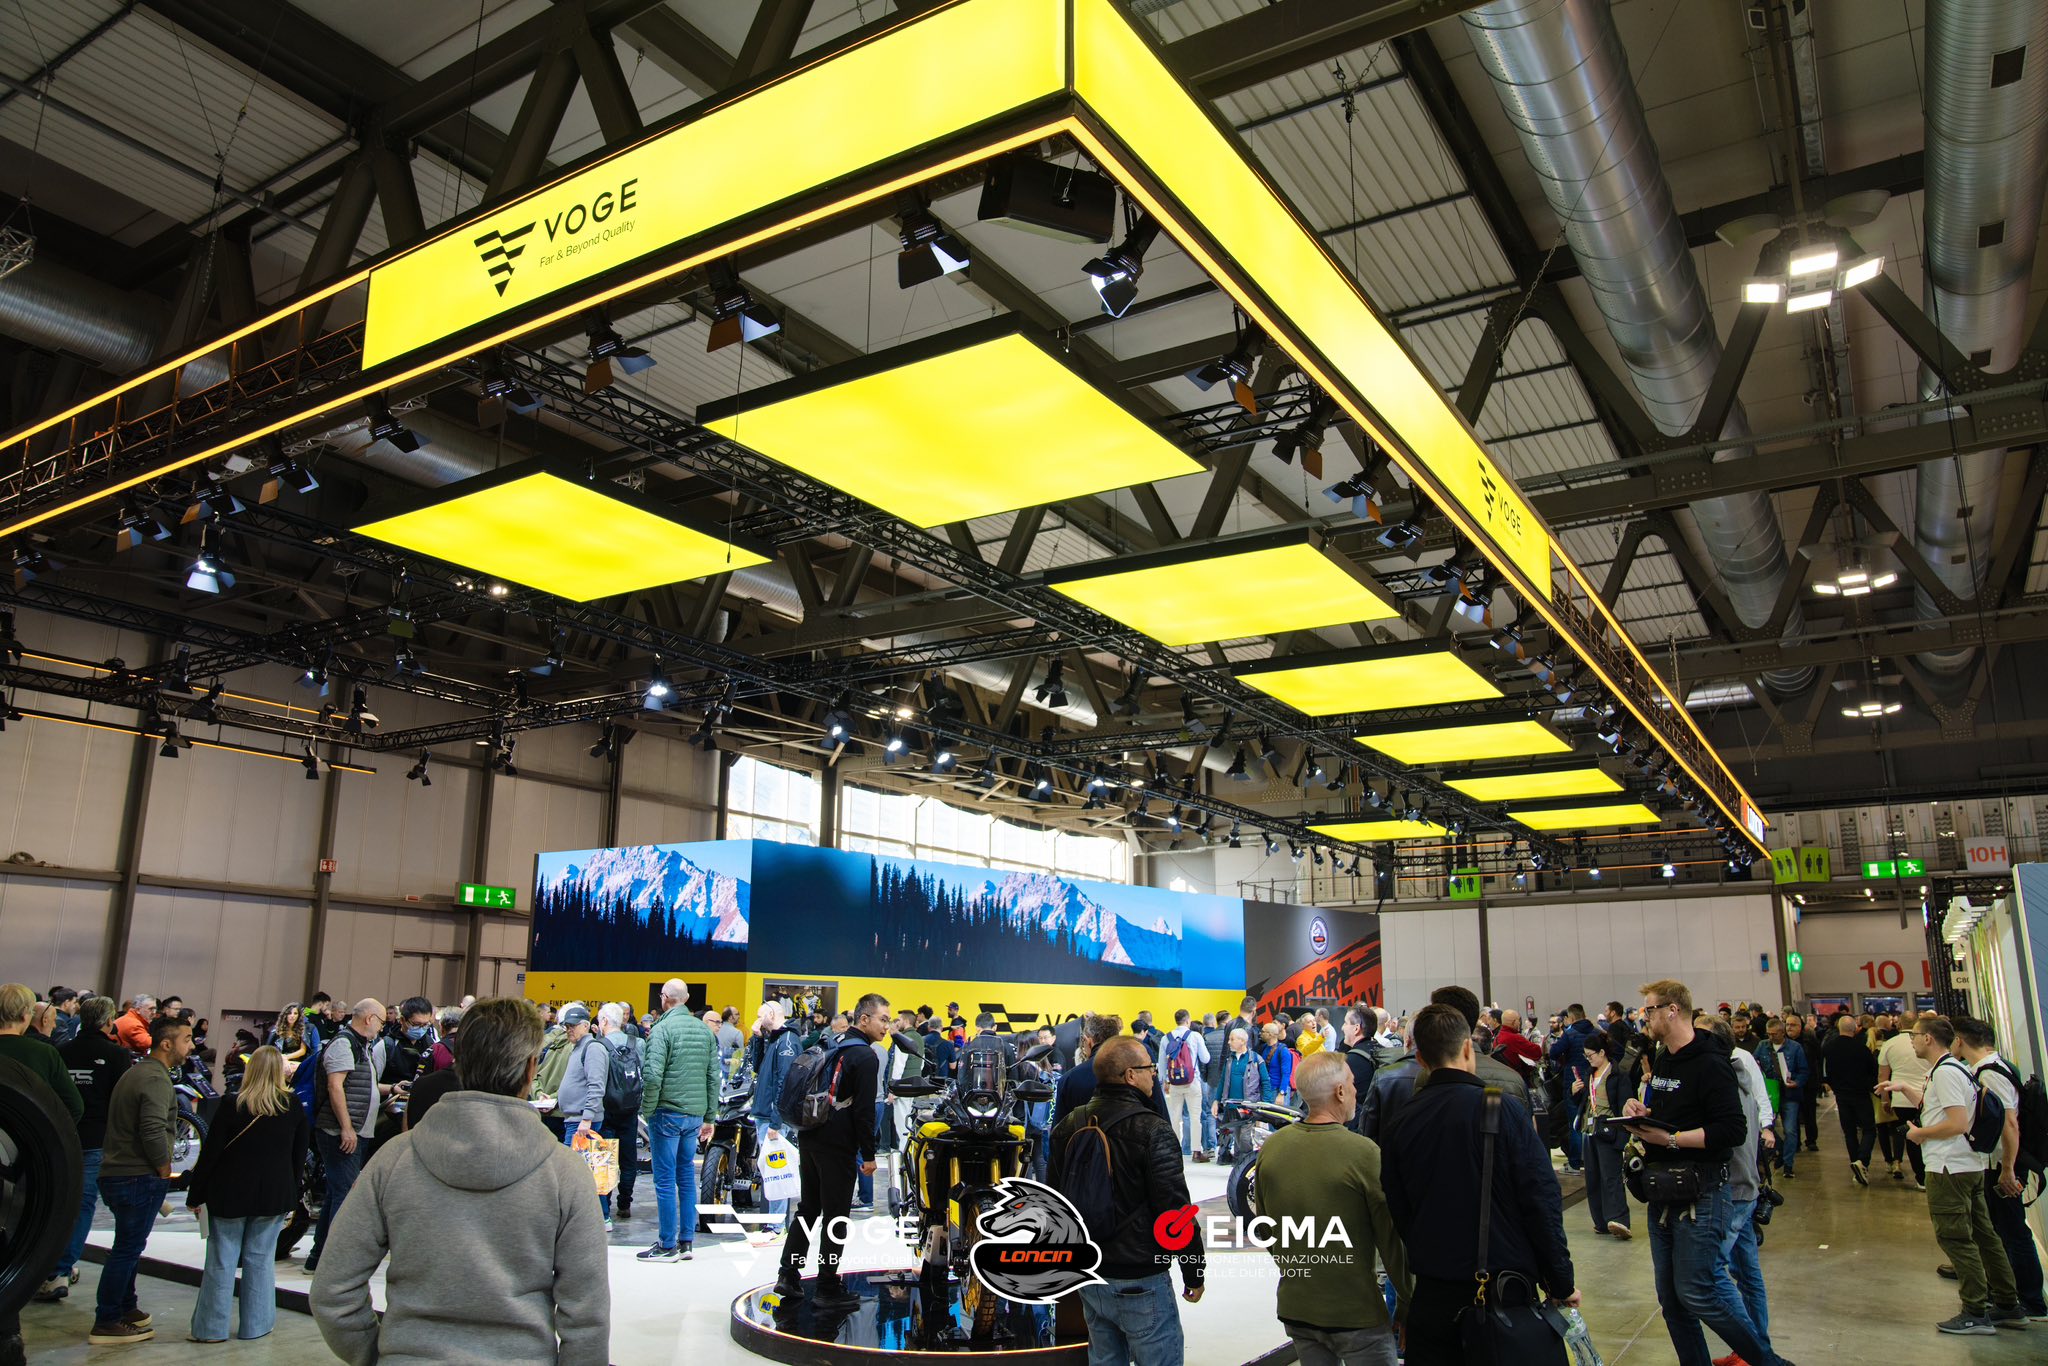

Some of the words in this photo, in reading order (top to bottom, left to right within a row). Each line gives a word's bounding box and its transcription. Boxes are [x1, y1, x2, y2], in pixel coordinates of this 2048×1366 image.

[544, 178, 638, 243] VOGE
[540, 255, 555, 267] Far
[556, 249, 564, 261] &
[566, 233, 600, 257] Beyond
[602, 220, 636, 241] Quality
[1498, 491, 1521, 536] VOGE
[1967, 846, 2007, 863] 10H
[1860, 960, 1904, 989] 10
